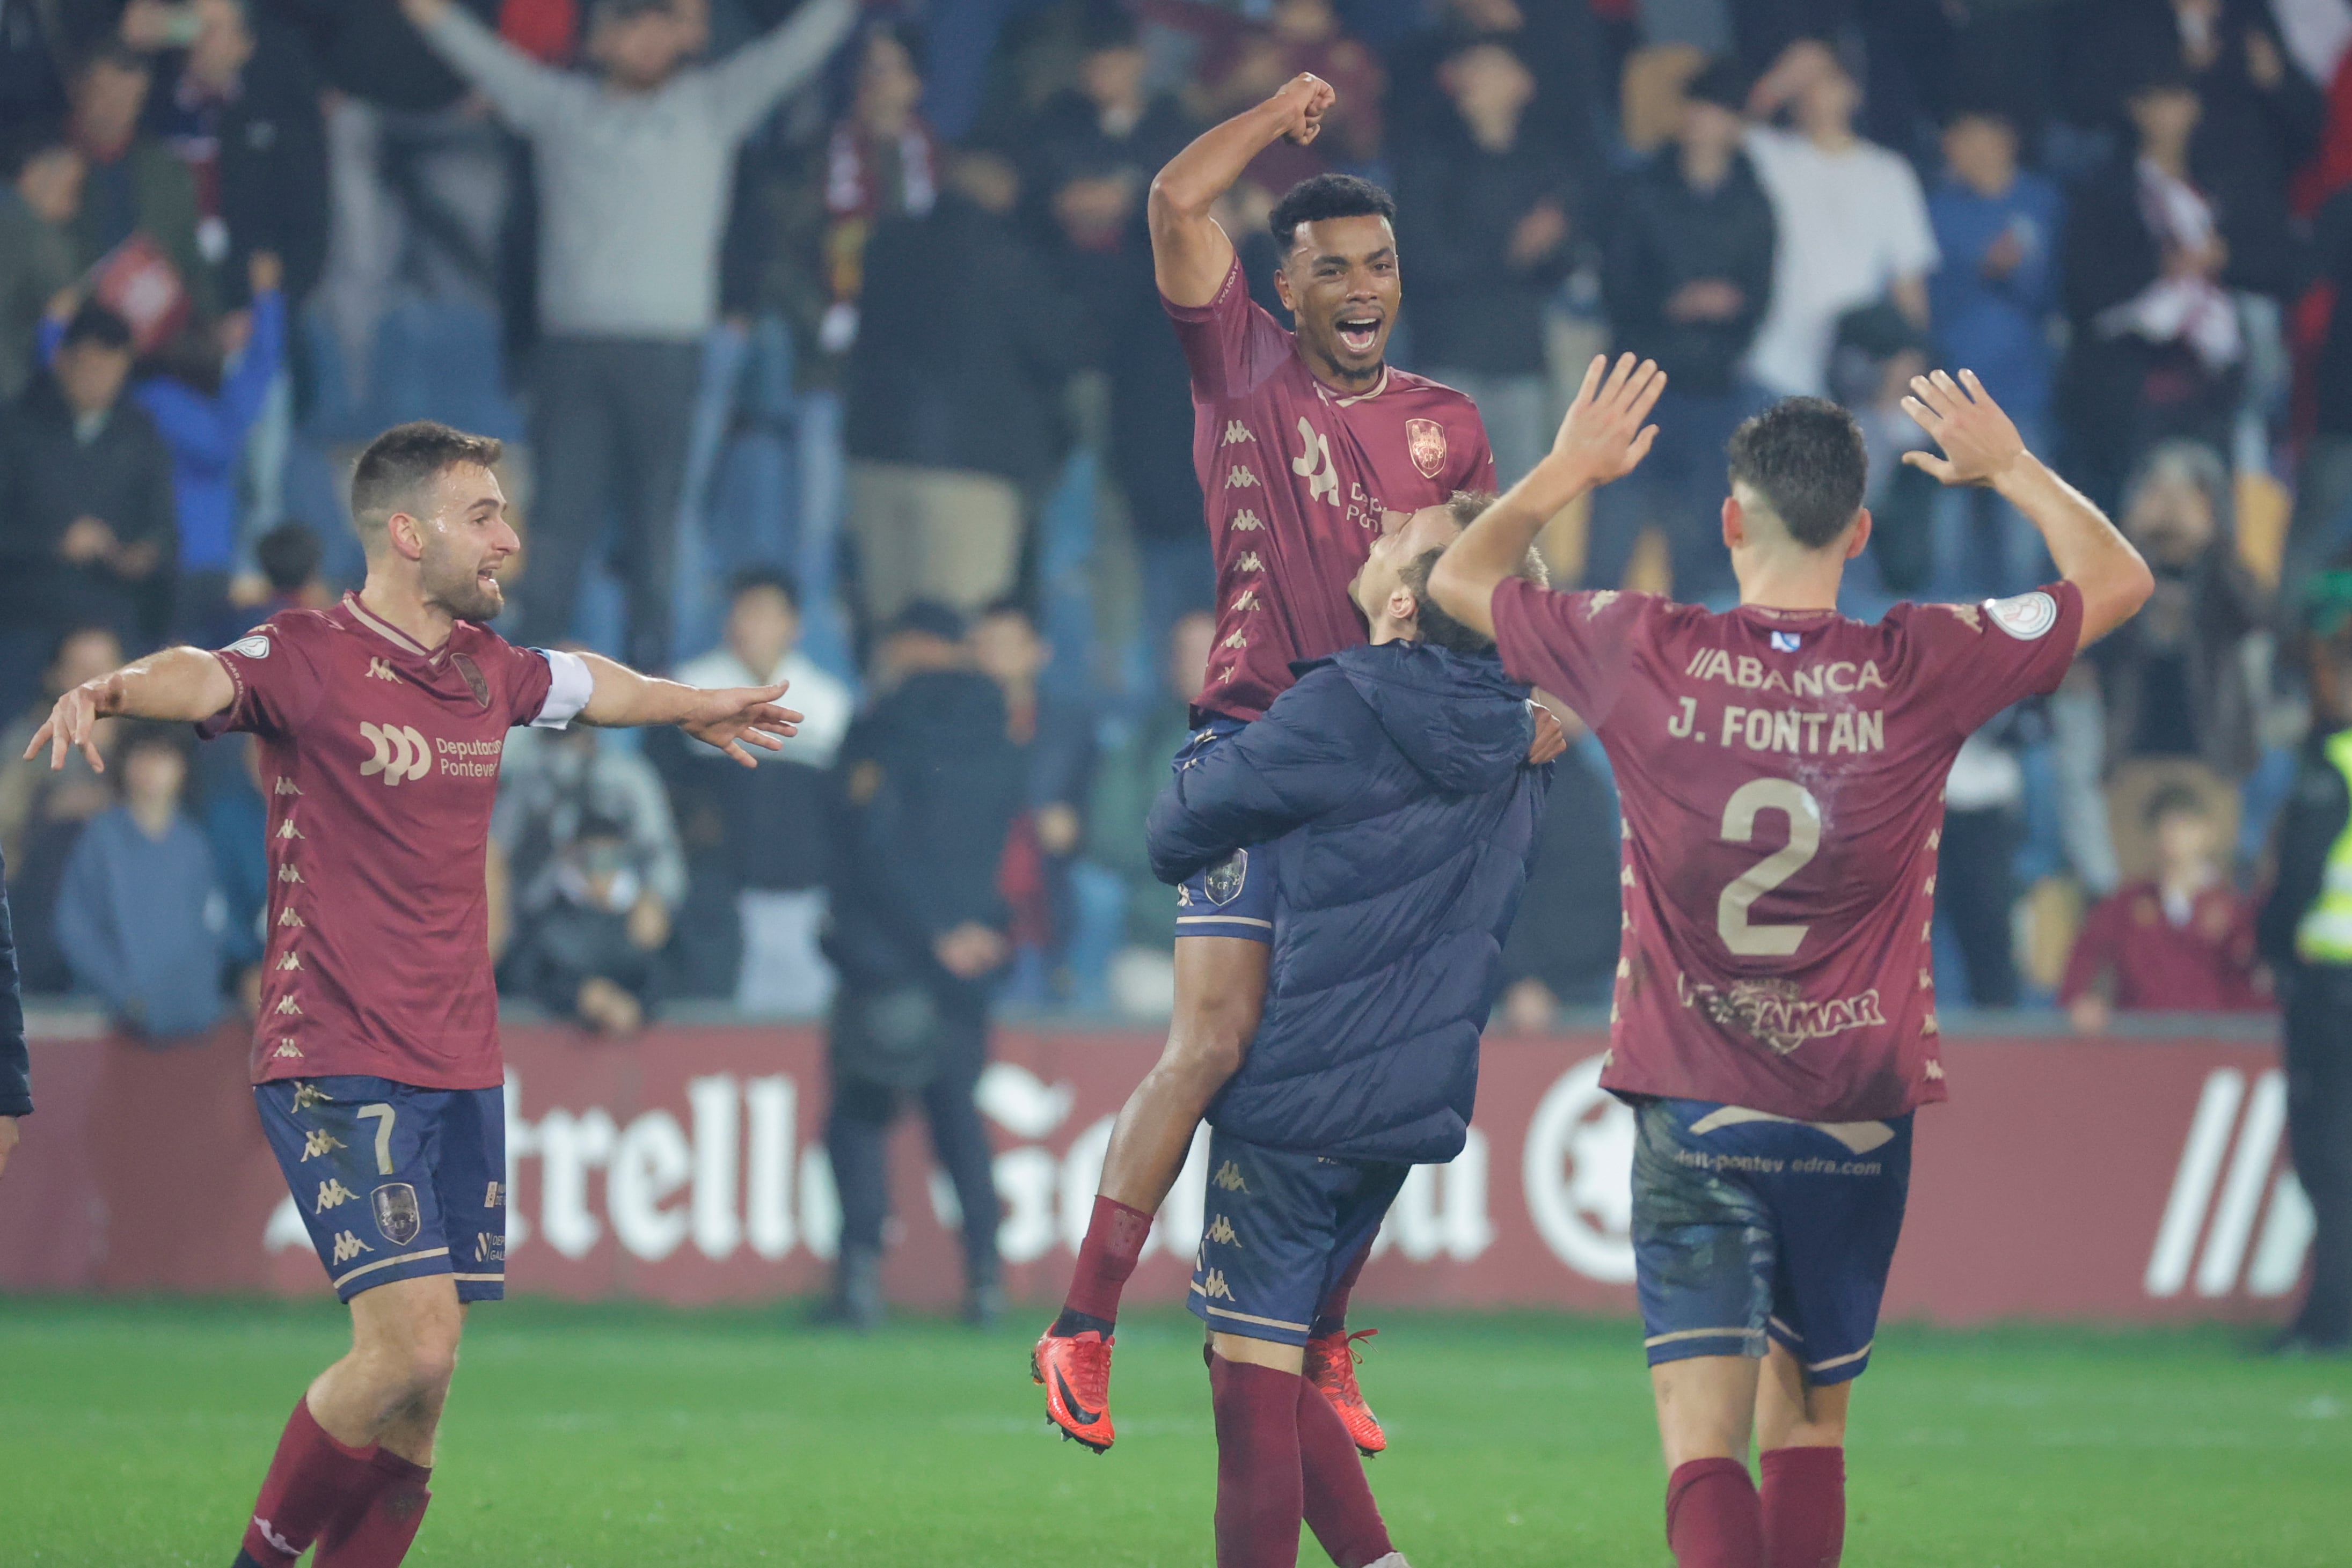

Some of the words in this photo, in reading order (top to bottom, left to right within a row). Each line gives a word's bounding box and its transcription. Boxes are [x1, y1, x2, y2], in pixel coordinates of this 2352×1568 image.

[1667, 696, 1706, 743] J.
[1717, 777, 1822, 957] 2
[355, 1102, 396, 1175] 7
